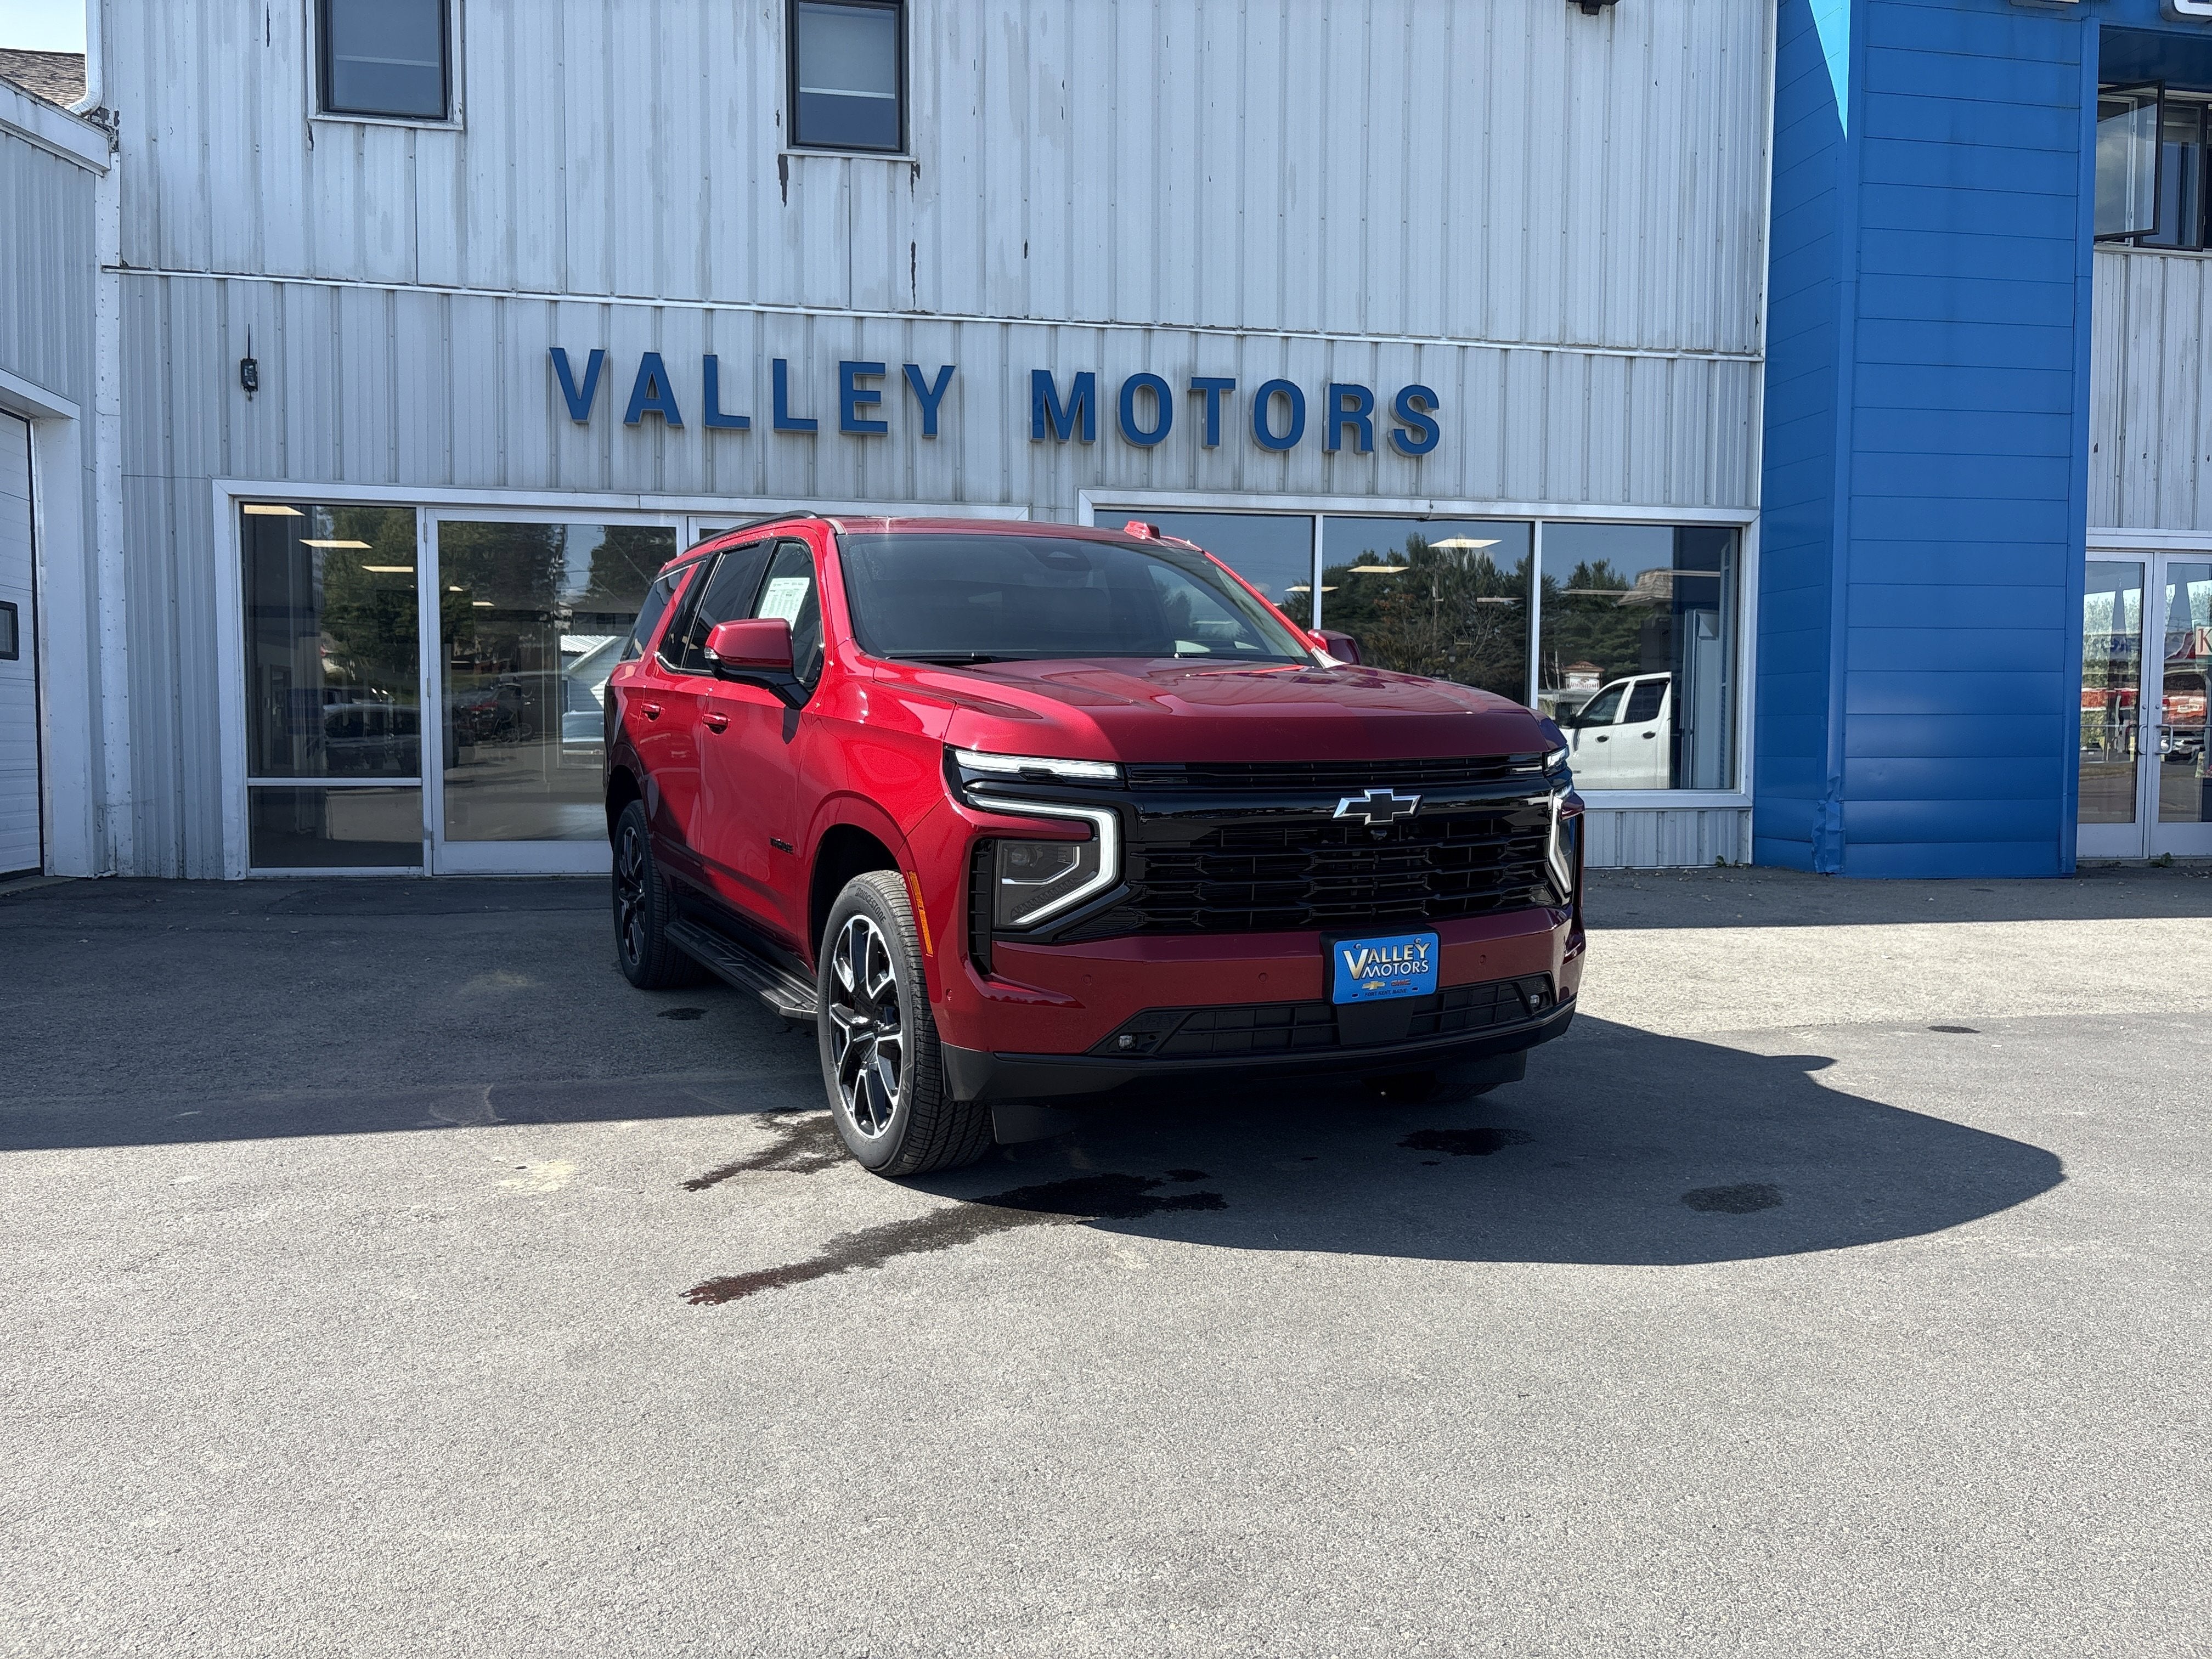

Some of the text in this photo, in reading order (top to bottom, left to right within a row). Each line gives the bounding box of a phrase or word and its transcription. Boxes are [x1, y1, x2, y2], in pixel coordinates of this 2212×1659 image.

[549, 347, 1440, 458] VALLEY MOTORS
[855, 887, 887, 924] BRIDGESTONE
[1342, 942, 1431, 980] VALLEY
[1361, 960, 1429, 979] MOTORS
